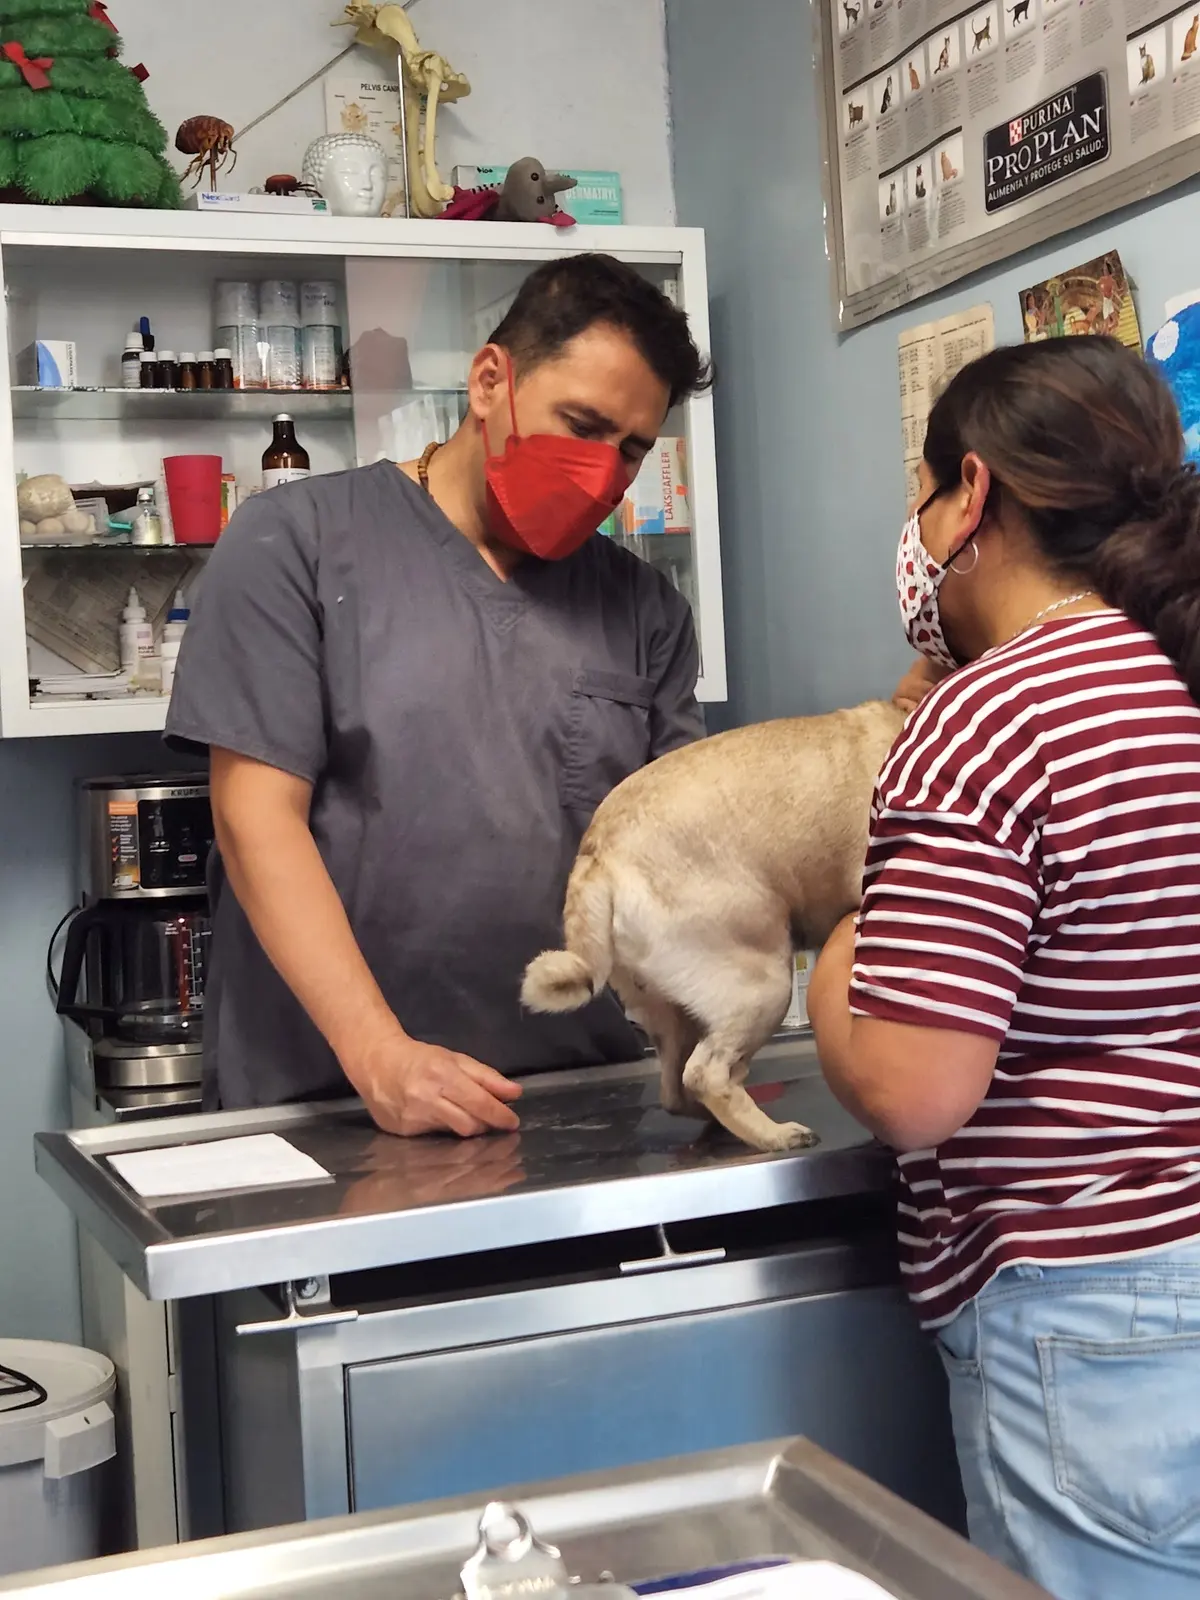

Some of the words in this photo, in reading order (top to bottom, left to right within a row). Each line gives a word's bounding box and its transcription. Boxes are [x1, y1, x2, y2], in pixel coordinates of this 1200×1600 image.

[360, 83, 381, 91] PELVIS
[1022, 94, 1073, 135] PURINA
[987, 180, 1024, 203] ALIMENTA
[1023, 174, 1030, 186] Y
[1030, 159, 1062, 183] PROTEGE
[1063, 152, 1074, 166] SU
[170, 788, 201, 797] KRUPS
